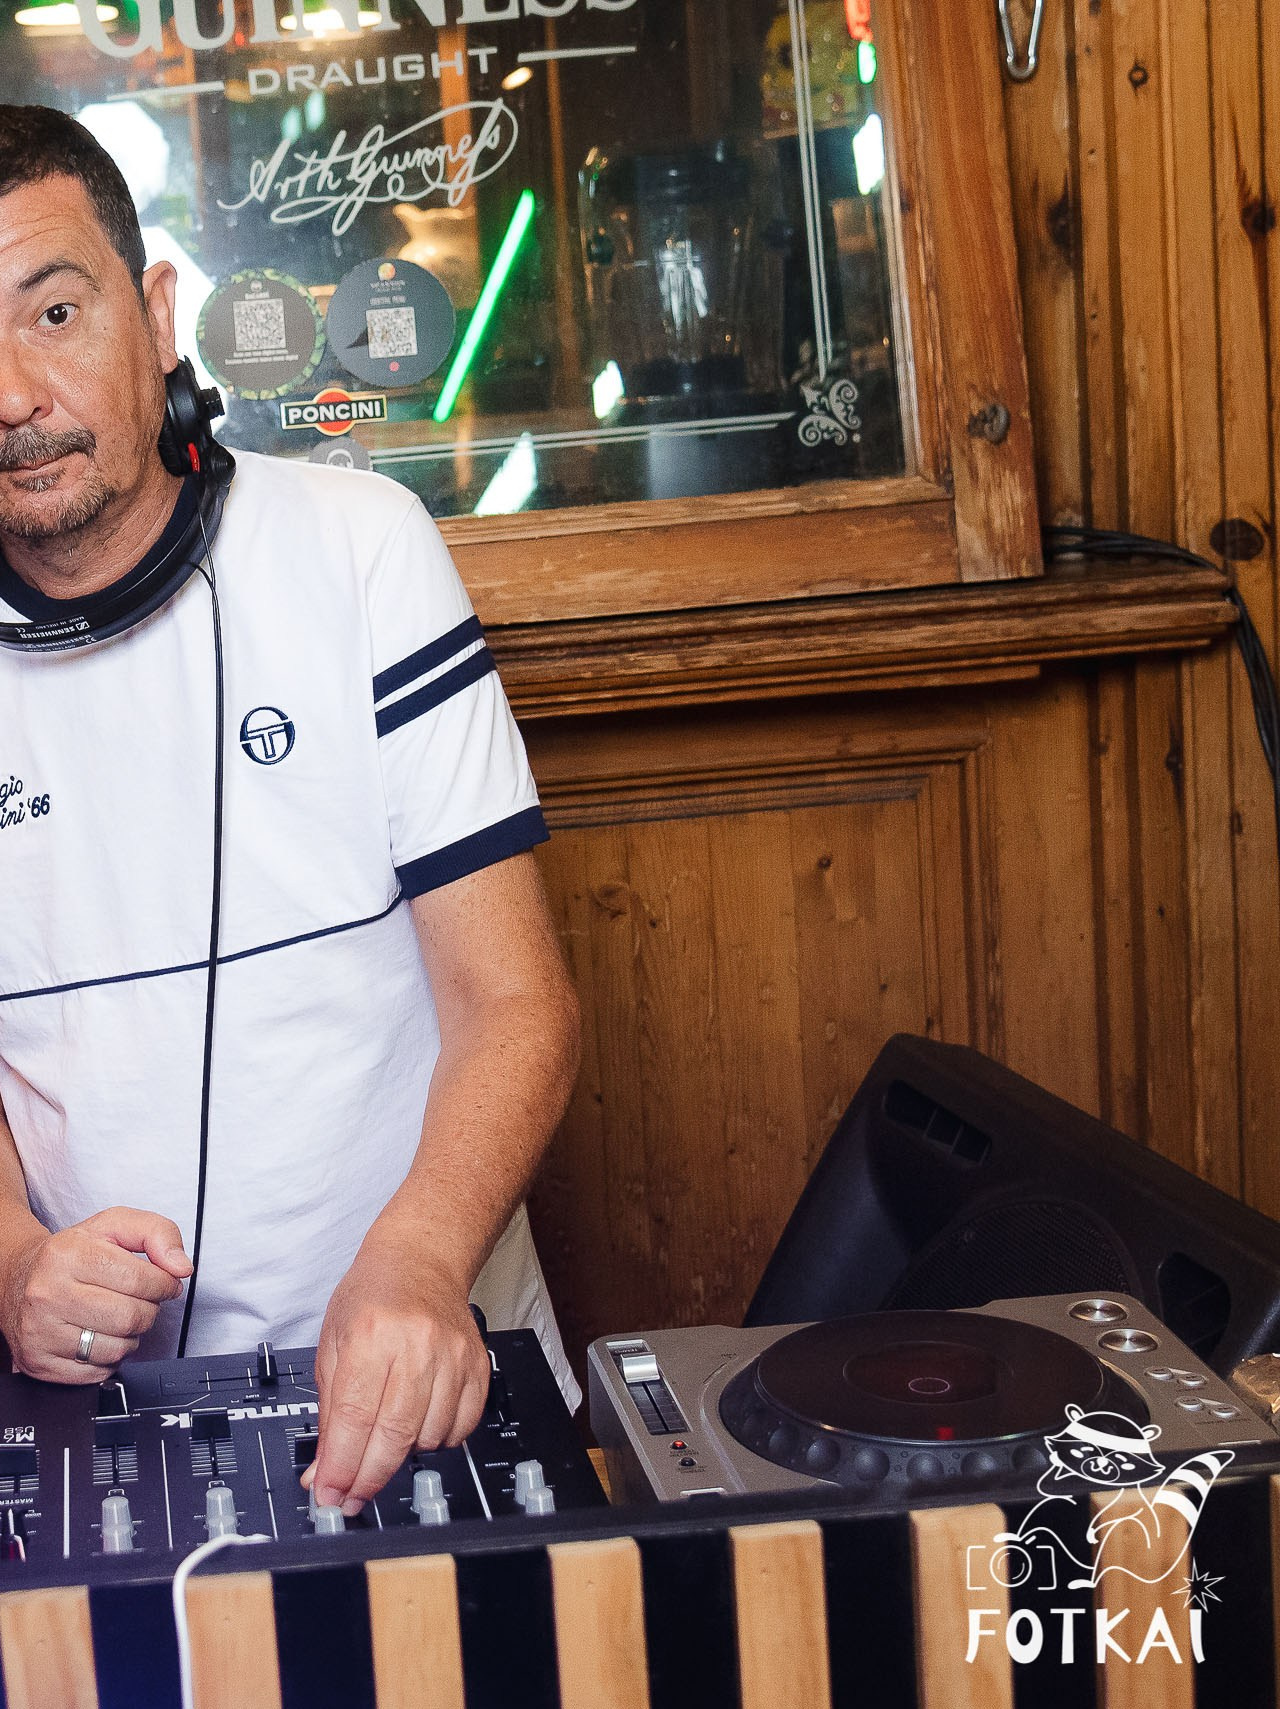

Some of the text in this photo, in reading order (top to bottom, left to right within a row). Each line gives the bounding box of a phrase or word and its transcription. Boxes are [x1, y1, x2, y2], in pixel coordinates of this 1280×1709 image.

[248, 47, 499, 97] DRAUGHT
[287, 400, 382, 425] PONCINI
[20, 626, 76, 639] SENNHEISER
[4, 1426, 34, 1435] USB
